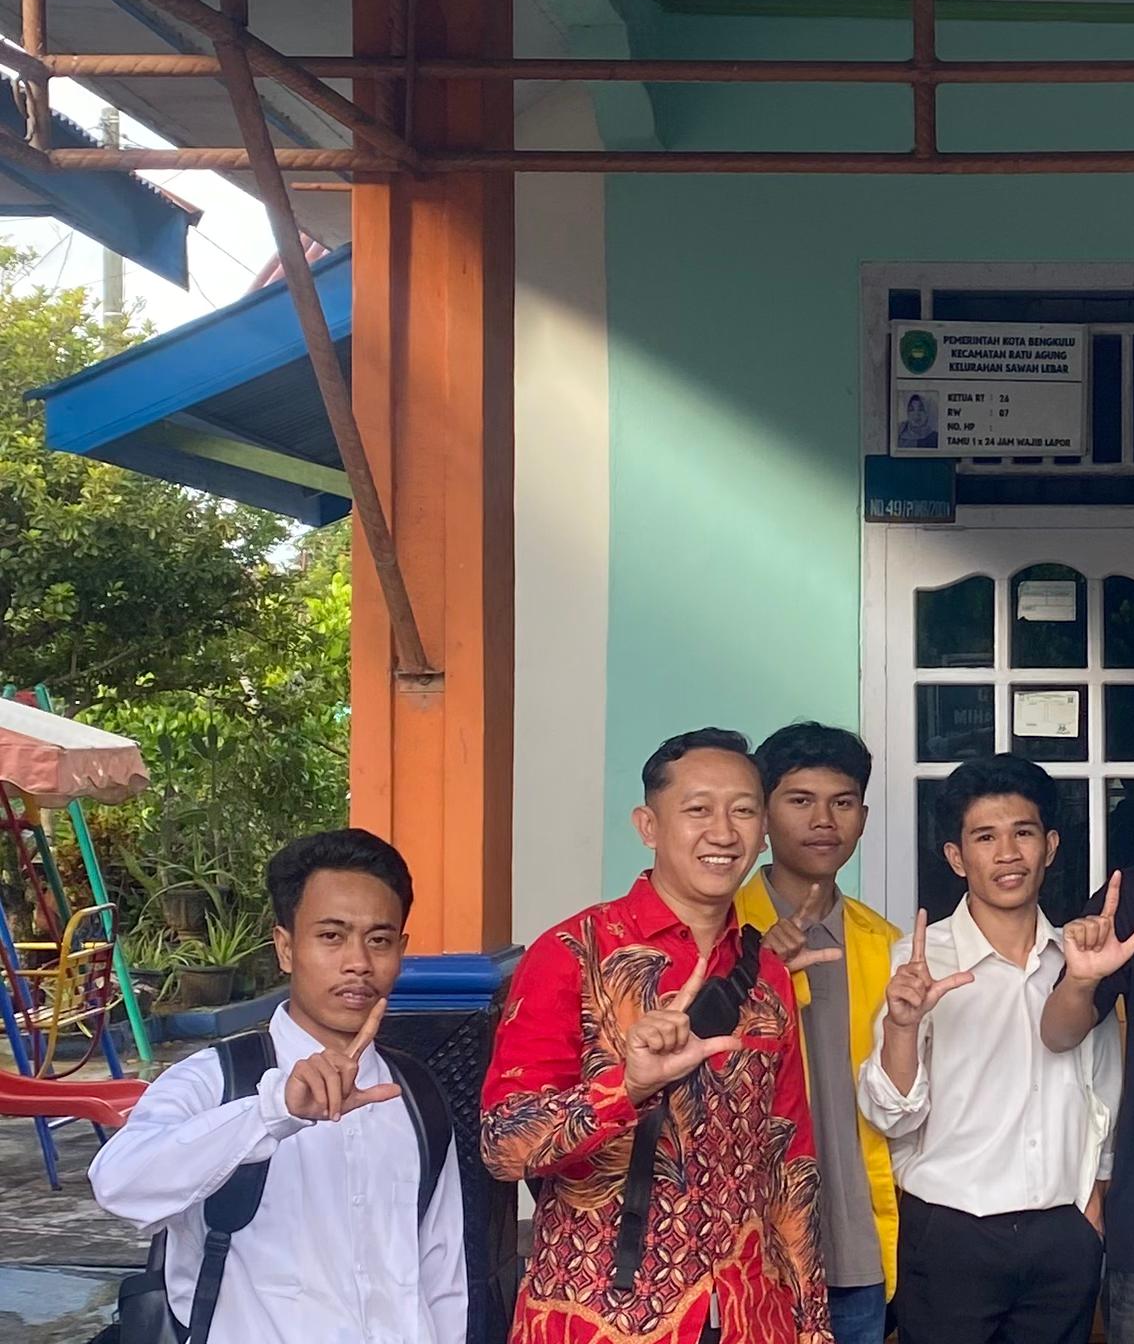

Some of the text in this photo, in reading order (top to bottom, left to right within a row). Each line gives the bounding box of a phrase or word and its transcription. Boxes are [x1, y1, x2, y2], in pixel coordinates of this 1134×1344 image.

[943, 336, 1076, 347] PEMERINTAH KOTA BENGKULU
[951, 349, 1068, 360] KECAMATAN RATU AGUNG
[949, 362, 1069, 374] KELURAHAN SAWAH LEBAR
[947, 393, 973, 402] KETUA
[975, 394, 985, 402] RT
[947, 408, 962, 417] RW
[964, 423, 976, 431] HP
[947, 437, 970, 446] TAMU
[985, 438, 995, 446] 24
[997, 438, 1015, 446] JAM
[1016, 438, 1042, 447] WAJIB
[1045, 438, 1071, 447] LAPOR
